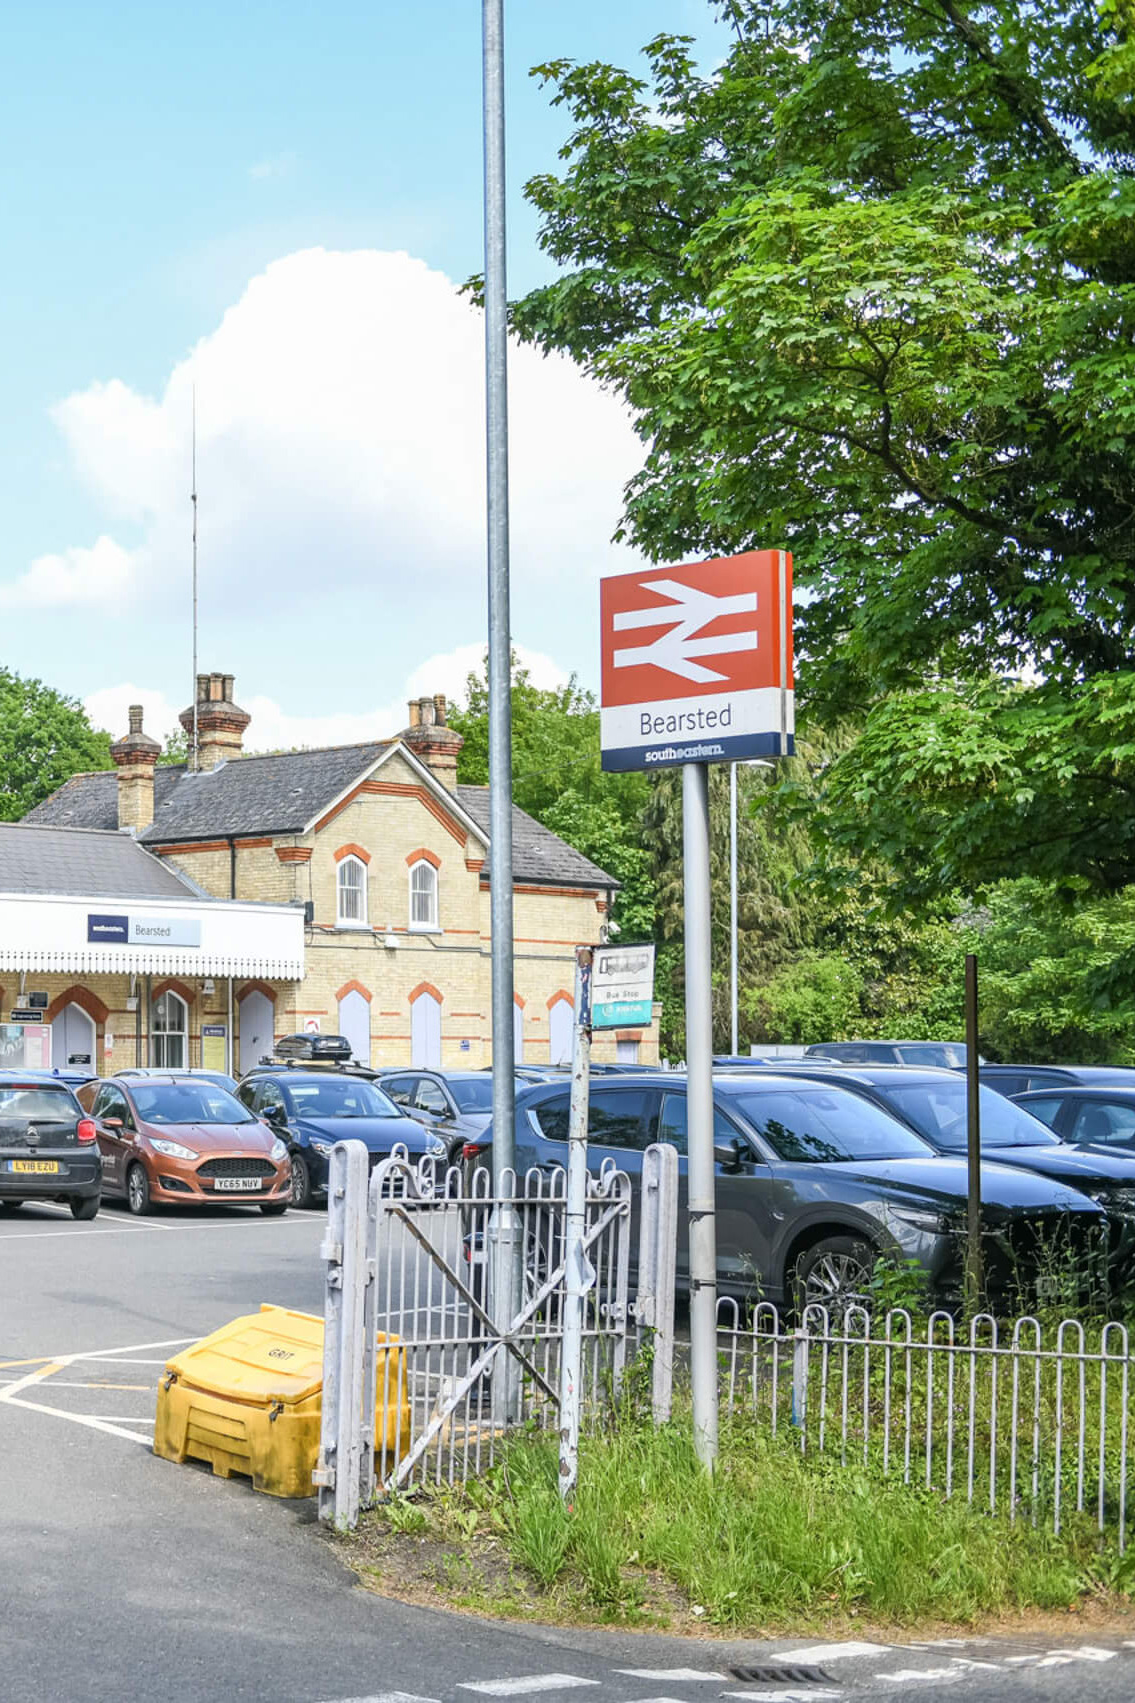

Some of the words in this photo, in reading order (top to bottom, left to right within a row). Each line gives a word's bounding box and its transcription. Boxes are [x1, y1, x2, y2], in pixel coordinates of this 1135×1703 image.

[640, 702, 732, 736] Bearsted
[135, 924, 171, 937] Bearsted
[268, 1348, 295, 1361] GRIT
